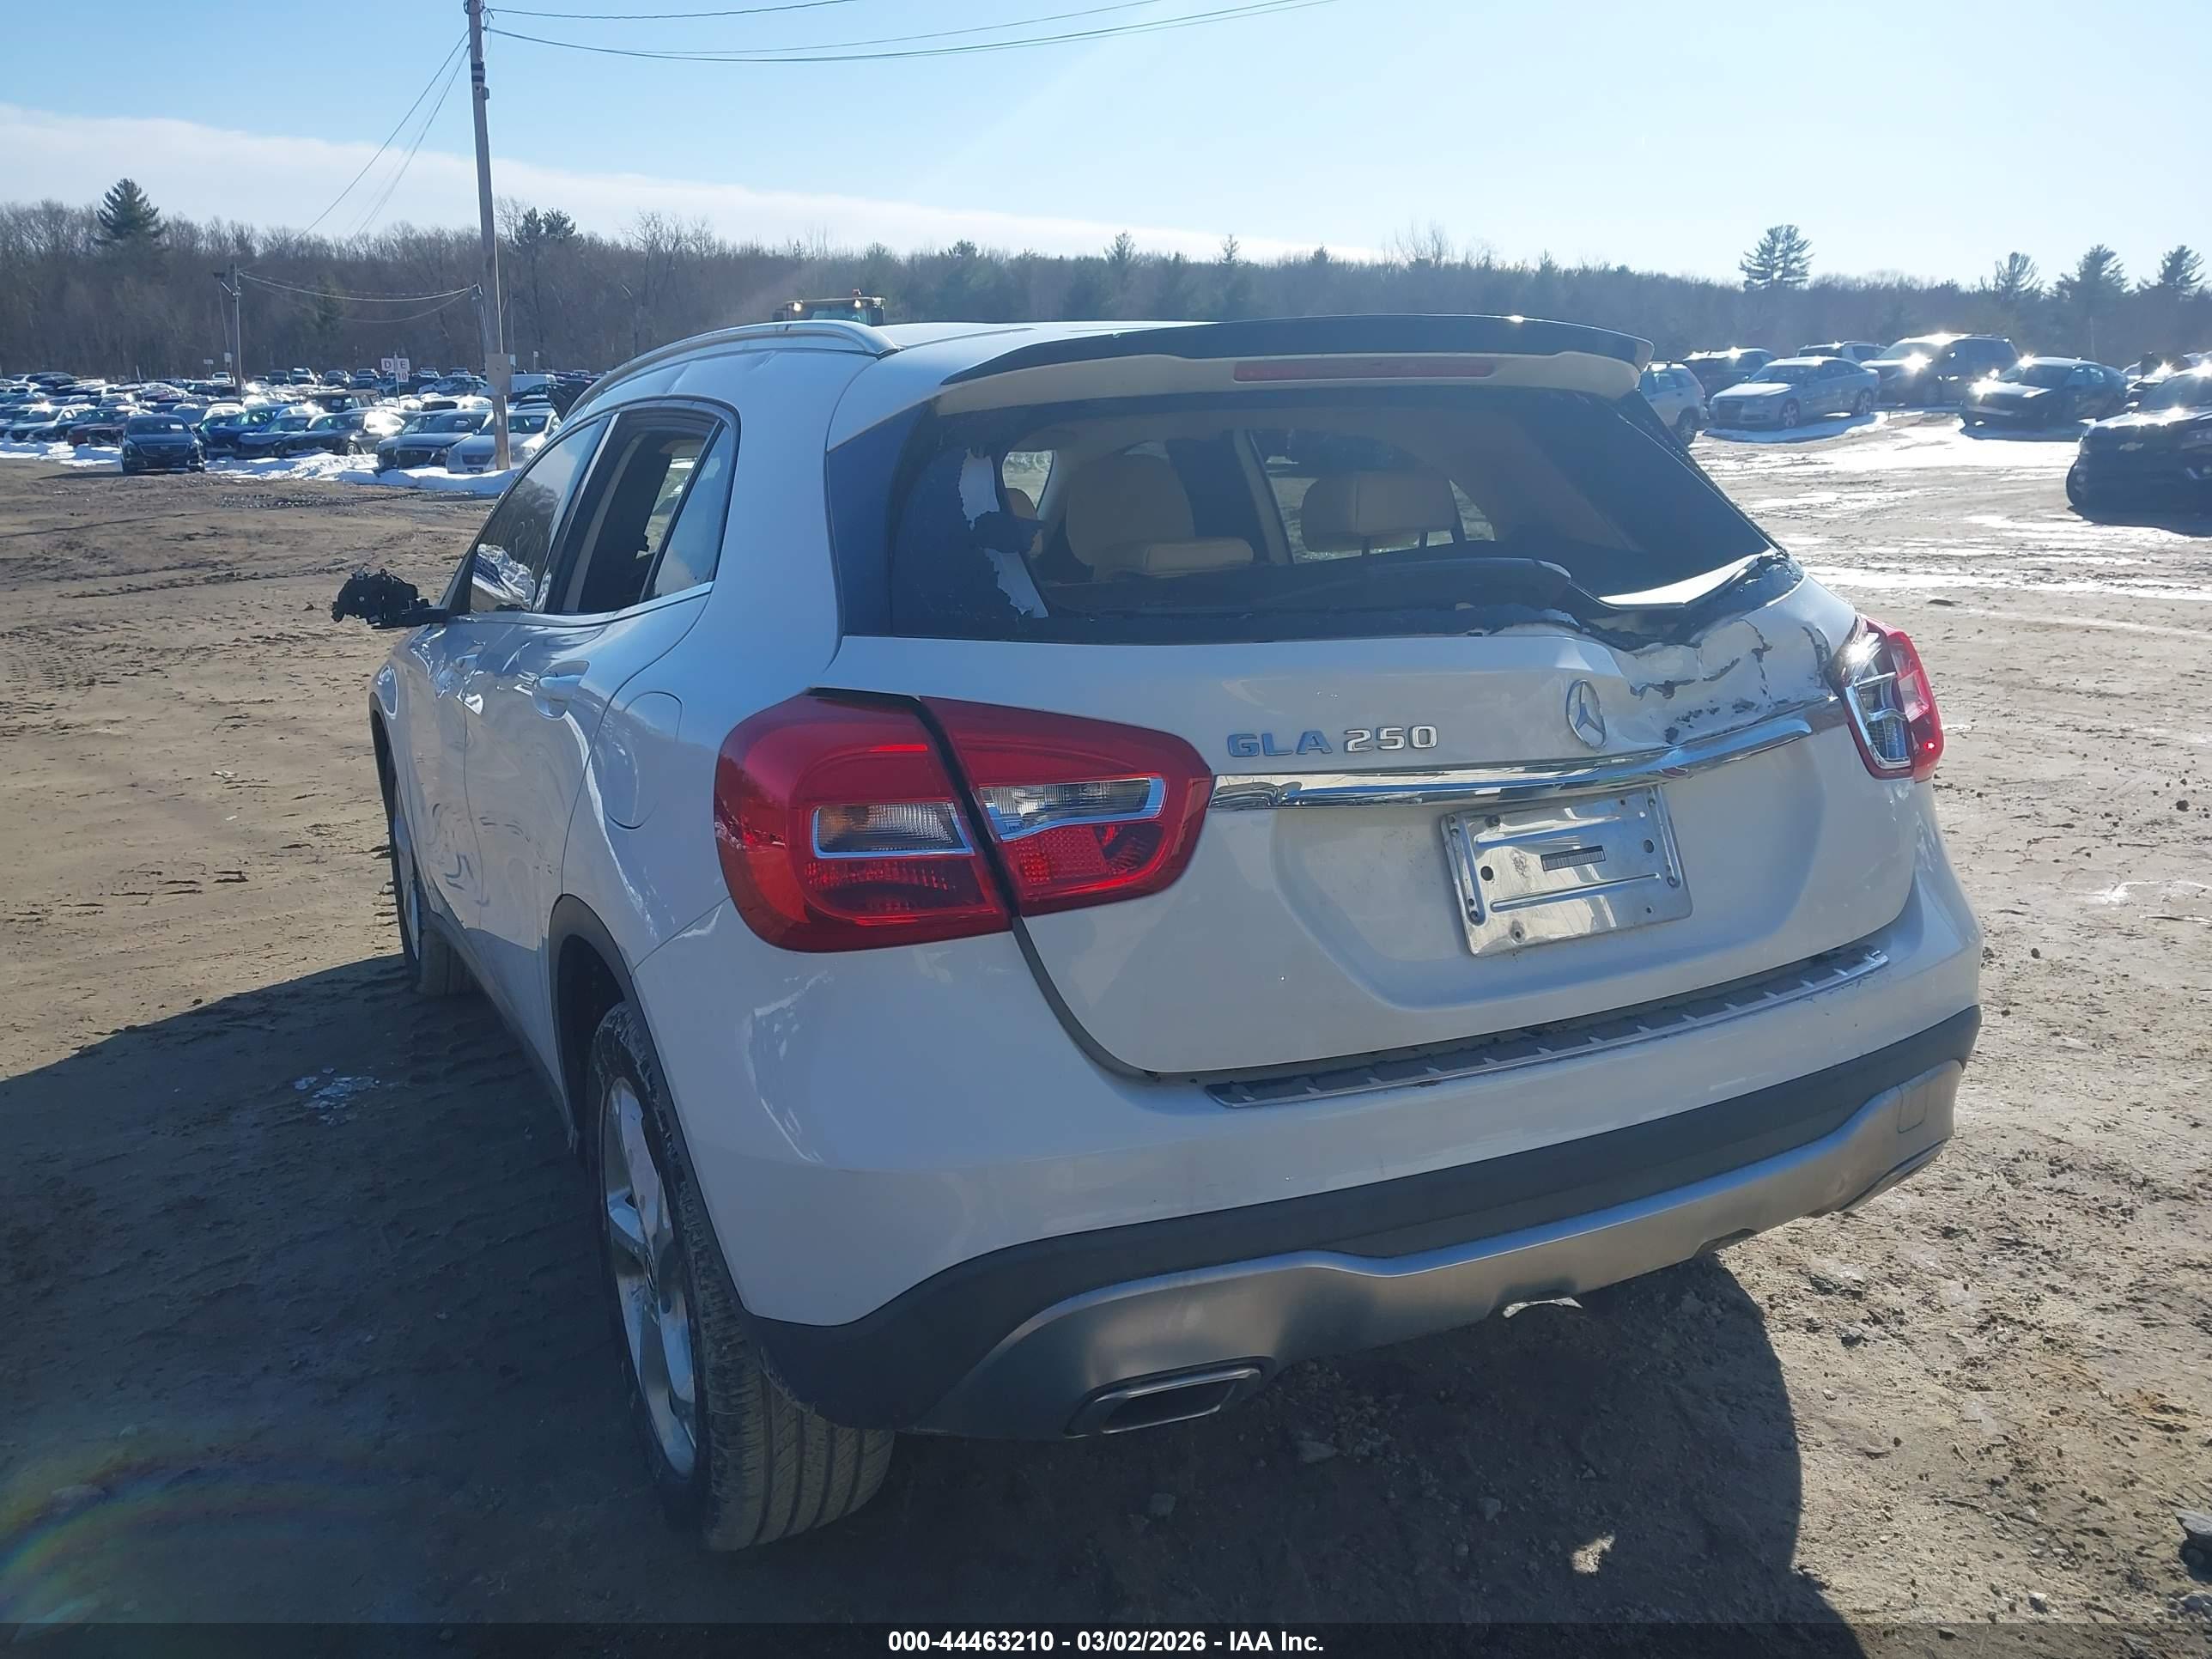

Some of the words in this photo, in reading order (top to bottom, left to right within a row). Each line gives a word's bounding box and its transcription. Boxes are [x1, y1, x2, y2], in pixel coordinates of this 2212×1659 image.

[384, 360, 392, 368] D
[400, 360, 406, 368] E
[398, 372, 407, 380] 10
[1227, 730, 1333, 757] GLA
[1344, 725, 1438, 753] 250
